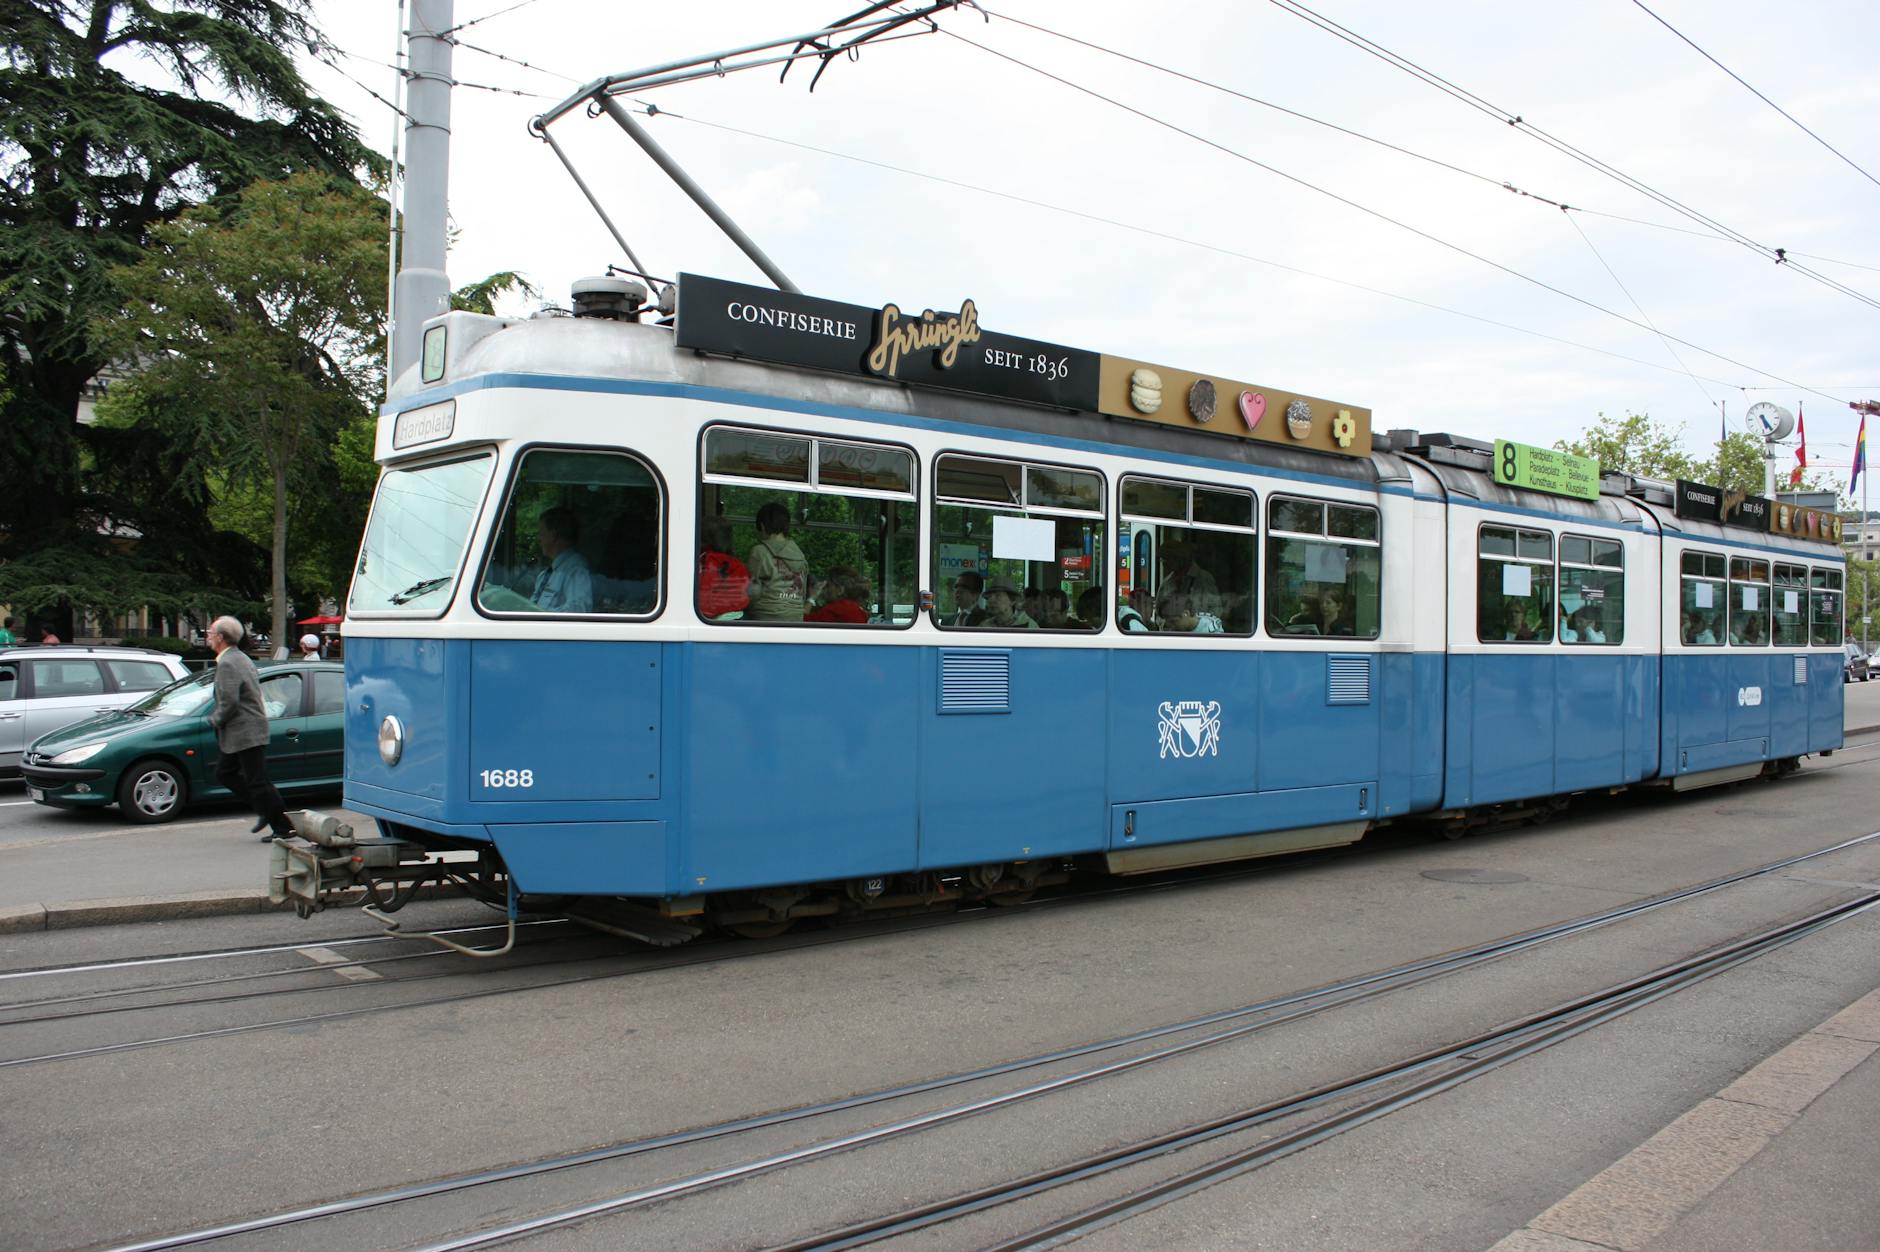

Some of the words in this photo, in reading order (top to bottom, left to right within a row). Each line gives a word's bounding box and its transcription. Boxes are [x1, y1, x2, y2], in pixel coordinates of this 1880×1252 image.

[727, 302, 856, 340] CONFISERIE
[870, 300, 980, 377] Sprüngli
[984, 348, 1023, 370] SEIT
[1029, 354, 1069, 381] 1836
[401, 413, 453, 441] Hardplatz
[1502, 443, 1517, 481] 8
[1687, 491, 1716, 505] CONFISERIE
[480, 769, 534, 788] 1688
